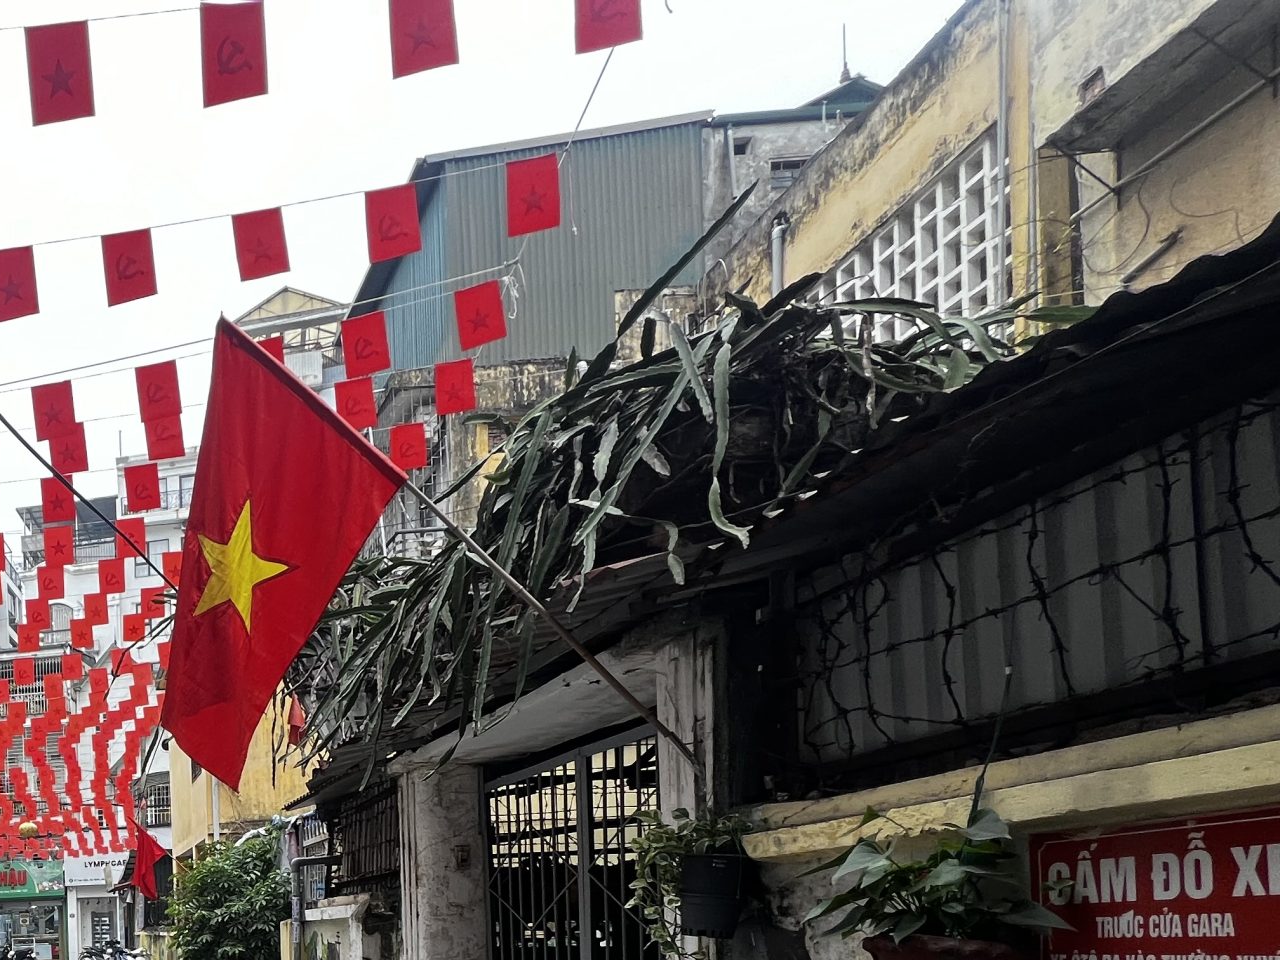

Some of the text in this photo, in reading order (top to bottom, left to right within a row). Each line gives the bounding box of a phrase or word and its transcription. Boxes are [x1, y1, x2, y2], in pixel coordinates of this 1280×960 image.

[1048, 843, 1137, 905] CẤM
[1151, 831, 1213, 900] ĐỖ
[1149, 907, 1183, 938] CỬA
[1187, 913, 1235, 937] GARA
